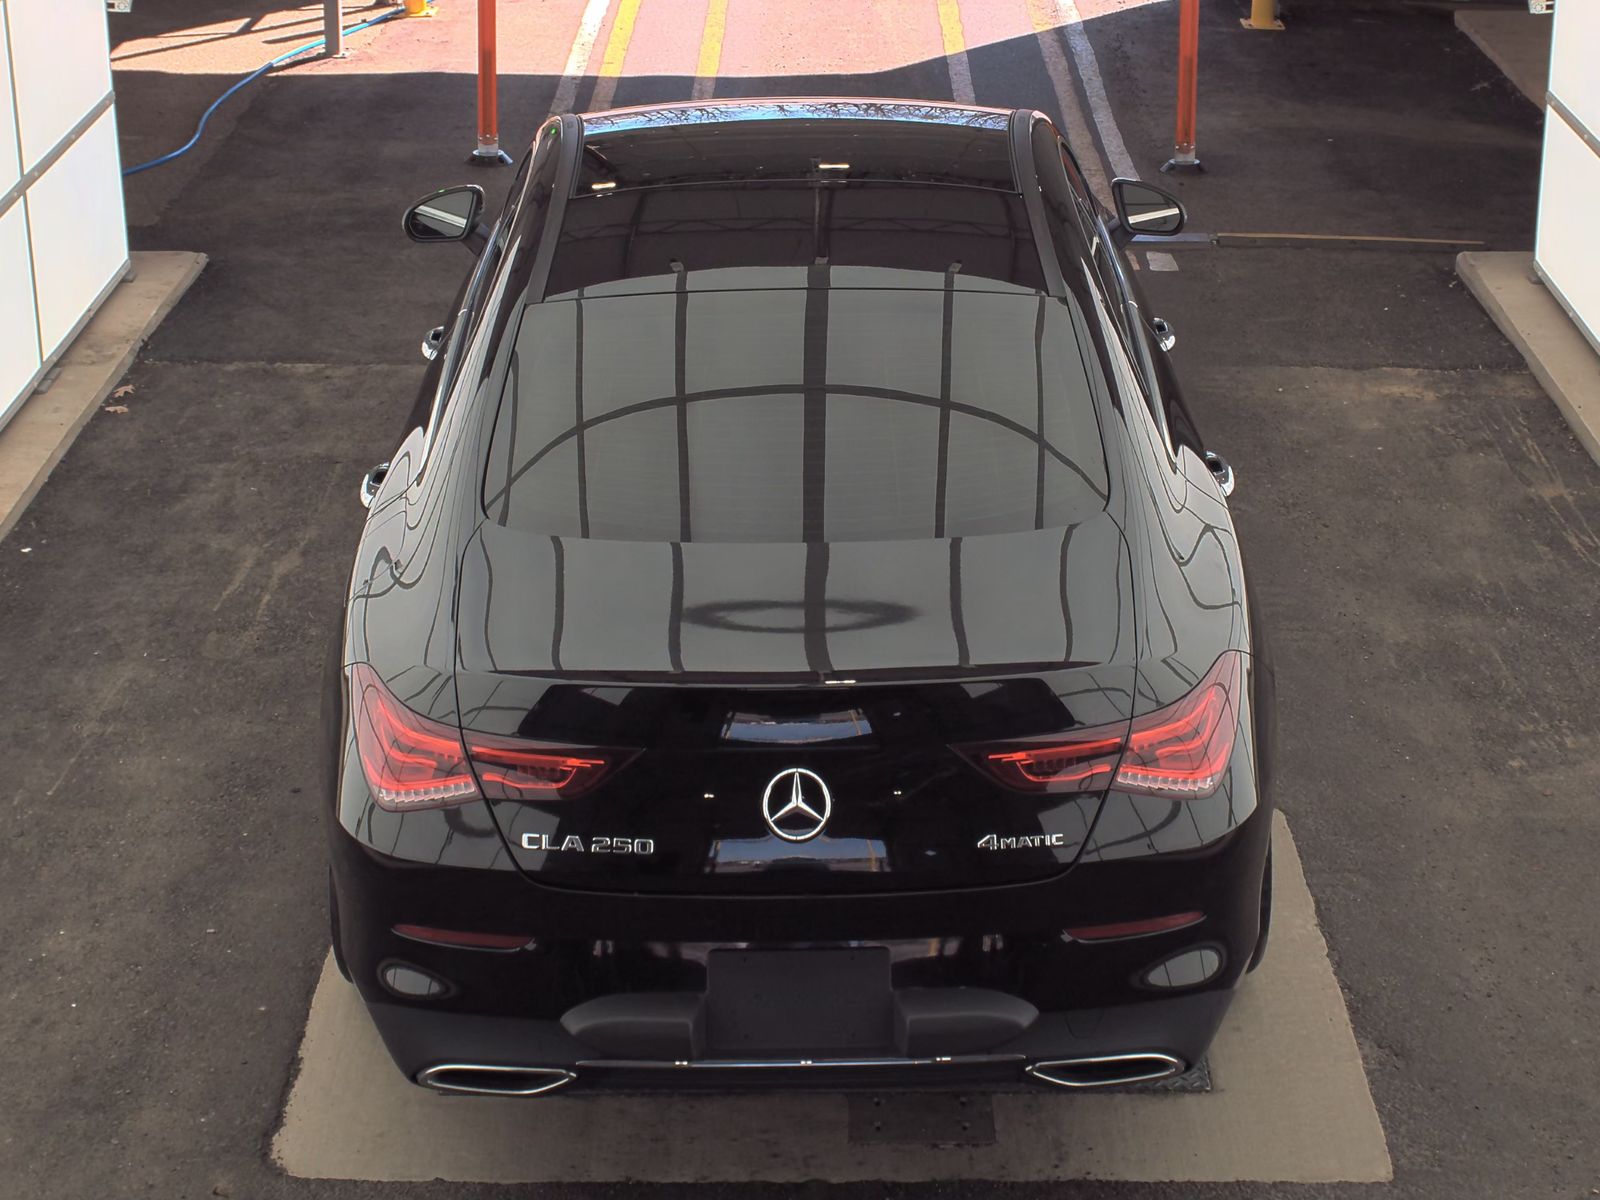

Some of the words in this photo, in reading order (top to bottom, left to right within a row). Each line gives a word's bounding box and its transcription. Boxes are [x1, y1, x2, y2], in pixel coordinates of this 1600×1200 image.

[521, 832, 585, 852] CLA
[591, 836, 655, 855] 250
[977, 833, 1064, 851] 4MATIC
